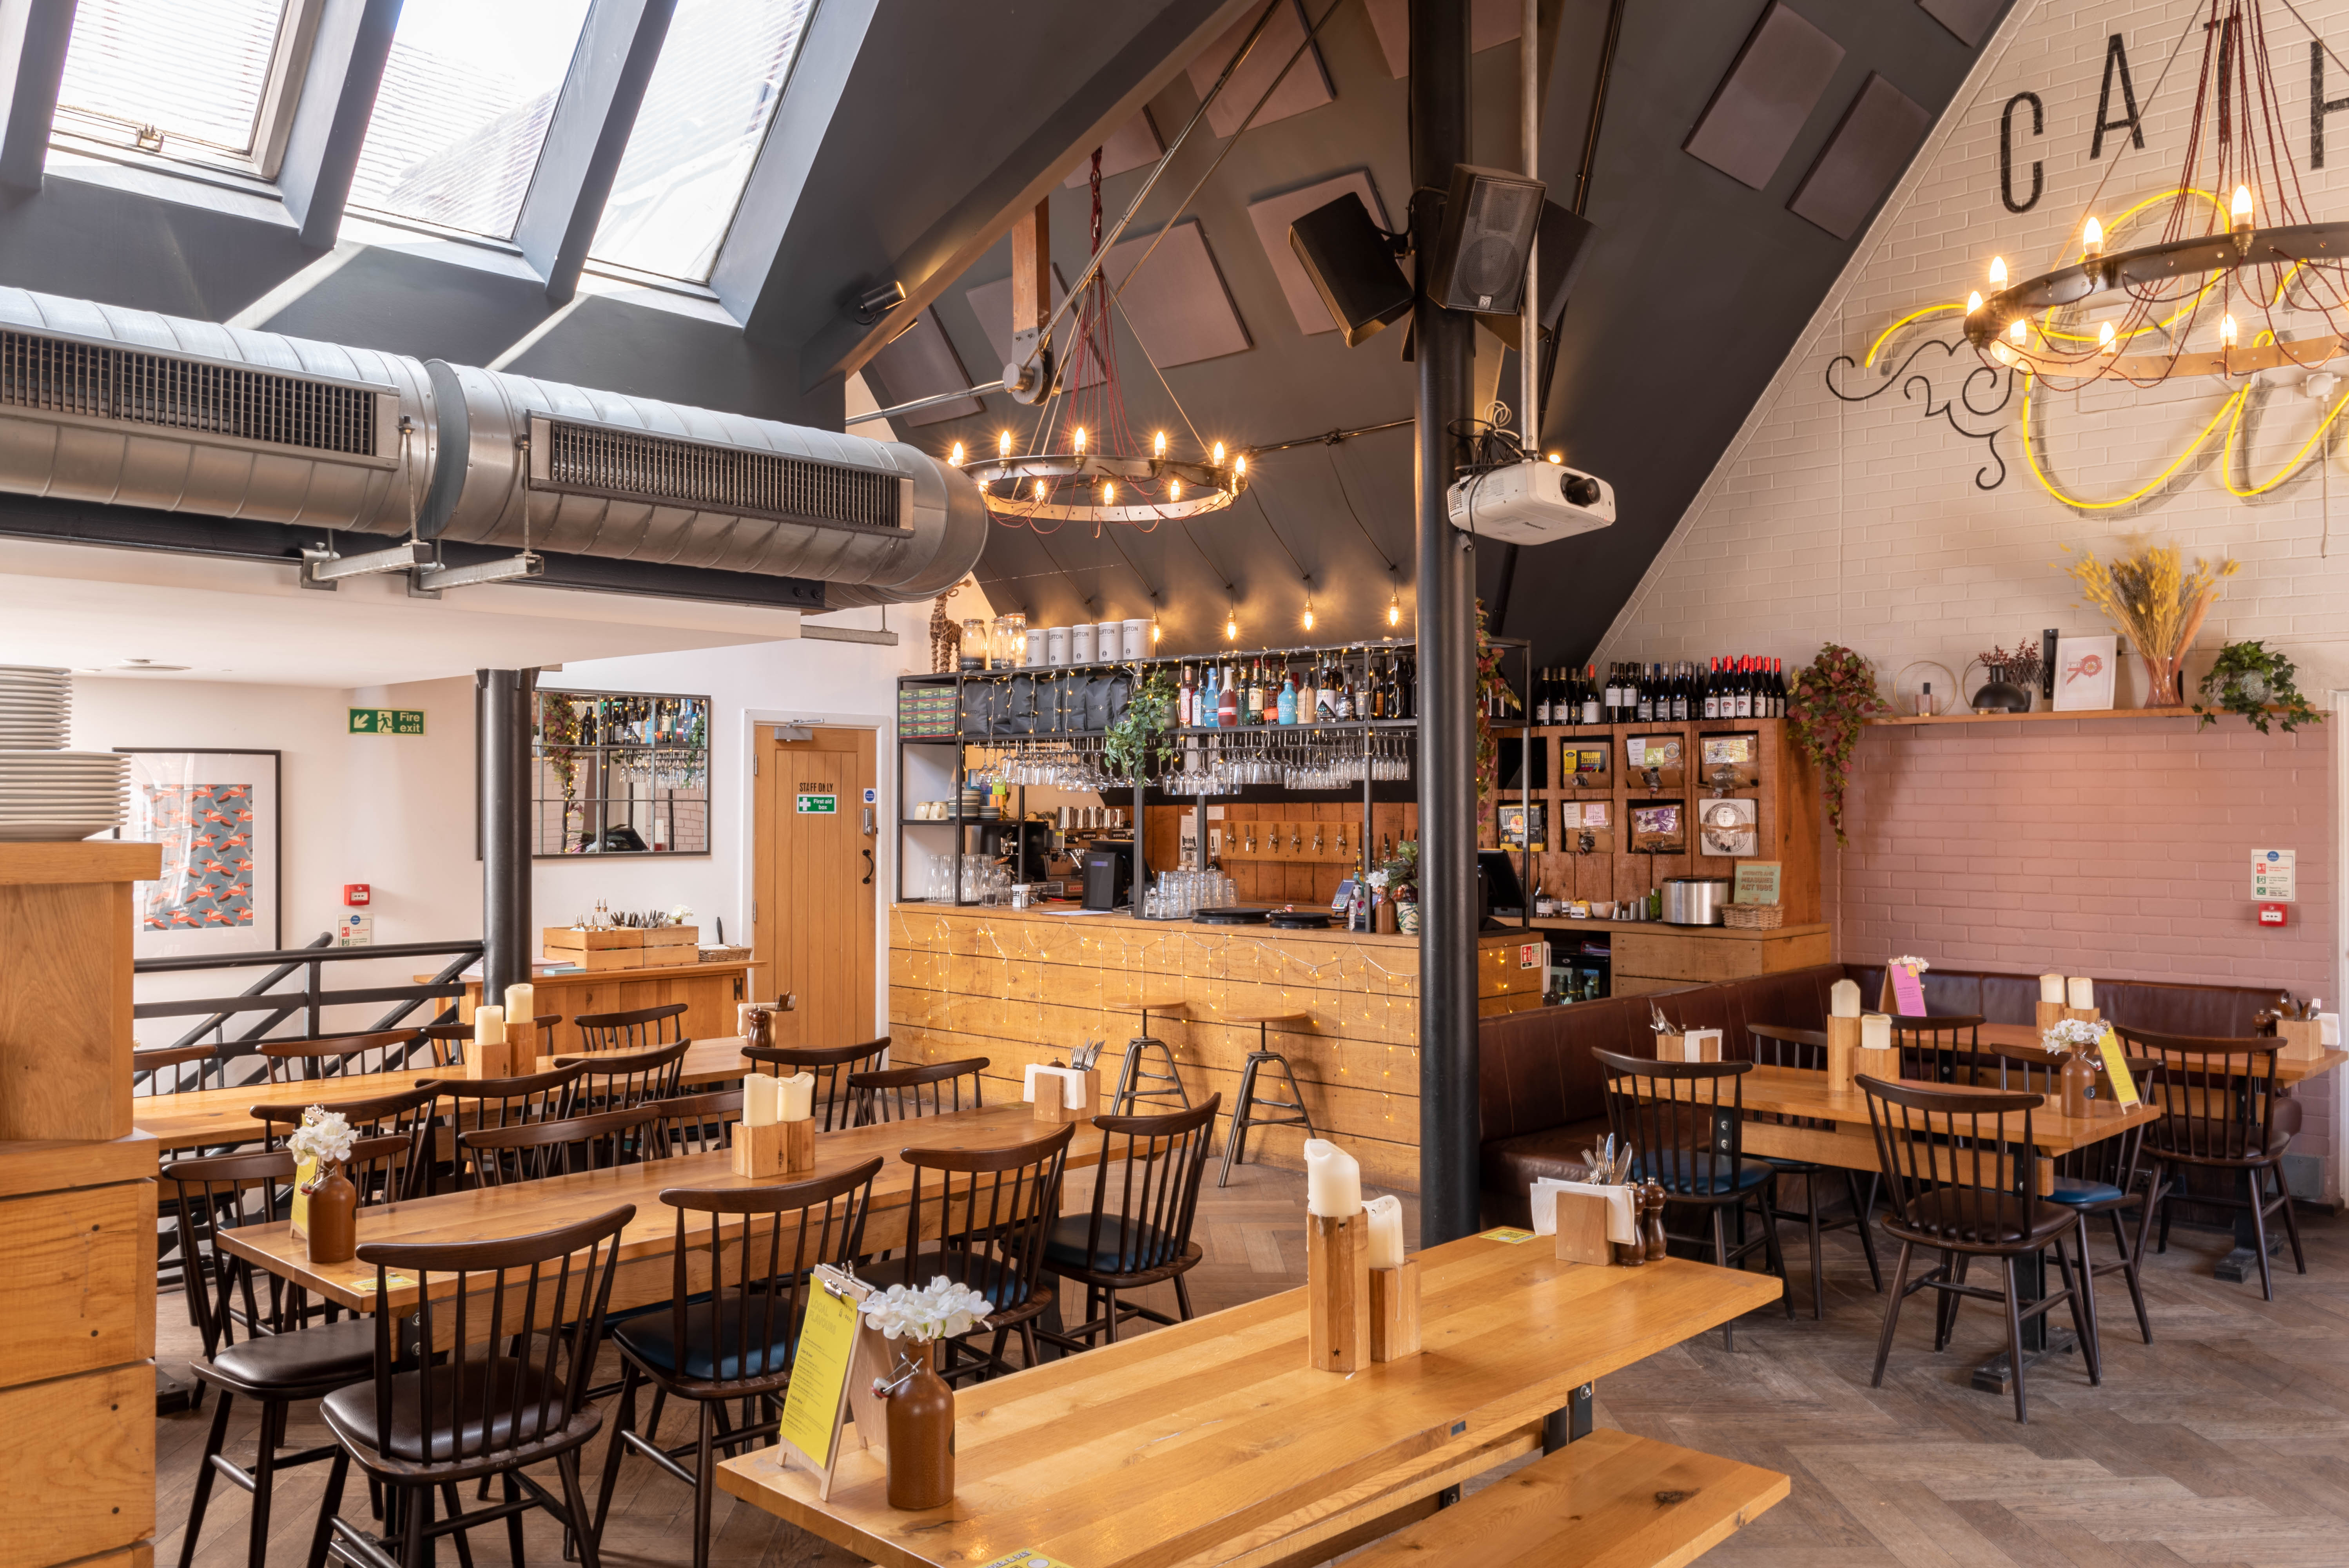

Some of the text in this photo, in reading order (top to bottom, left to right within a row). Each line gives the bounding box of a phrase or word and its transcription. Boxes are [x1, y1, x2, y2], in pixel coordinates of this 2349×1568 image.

[400, 712, 420, 721] Fire
[400, 723, 420, 732] exit
[799, 782, 834, 792] STAFF ONLY
[811, 1298, 828, 1317] LOCAL
[808, 1310, 836, 1336] FLAVOURS
[1013, 1550, 1032, 1560] PAY
